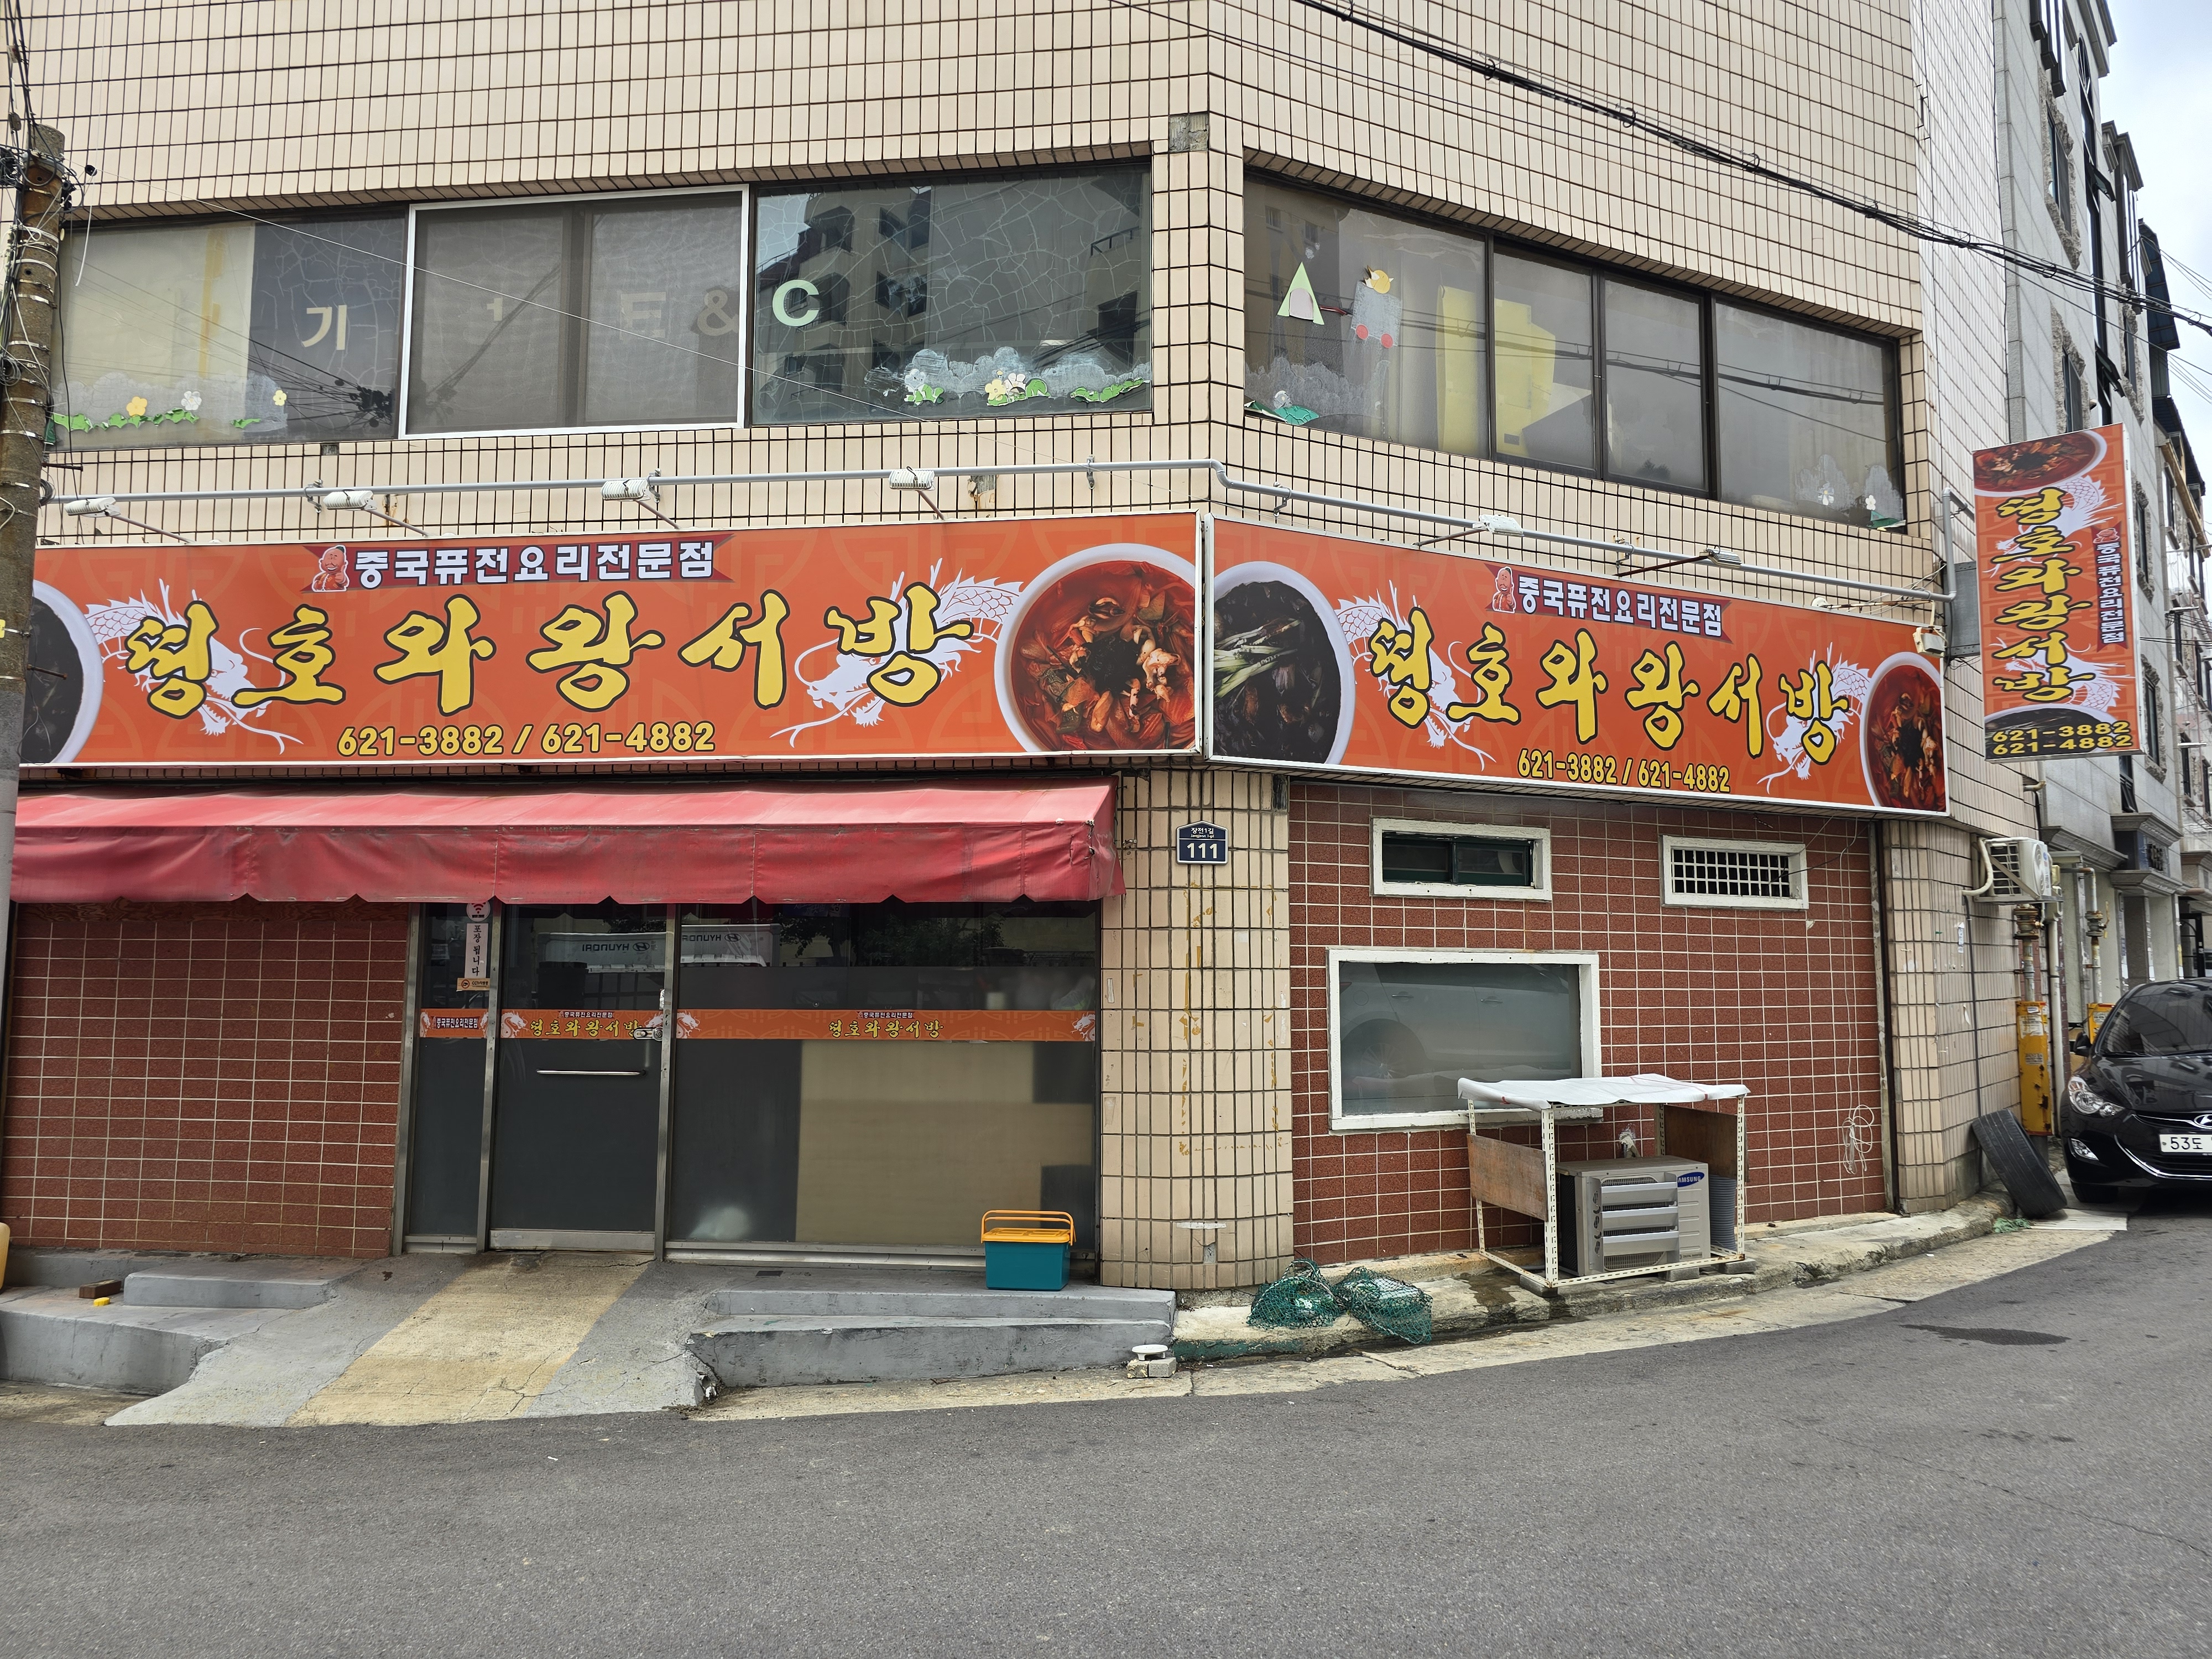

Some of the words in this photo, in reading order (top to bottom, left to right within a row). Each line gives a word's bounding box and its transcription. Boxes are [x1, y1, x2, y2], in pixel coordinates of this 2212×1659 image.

[302, 305, 347, 350] 기
[355, 540, 714, 589] 중국퓨전요리전문점
[1518, 575, 1722, 637] 중국퓨전요리전문점
[2097, 541, 2125, 644] 중국퓨전요리전문점
[337, 725, 504, 757] 621-3882
[540, 721, 715, 755] 621-4882
[1992, 721, 2130, 743] 621-3882
[1992, 734, 2133, 755] 621-4882
[1517, 748, 1618, 785] 621-3882
[1637, 759, 1731, 793] 621-4882
[1187, 843, 1217, 859] 111
[473, 925, 482, 943] 포장
[471, 945, 481, 977] 됩니다
[436, 1018, 478, 1029] 중국퓨전요리전문점
